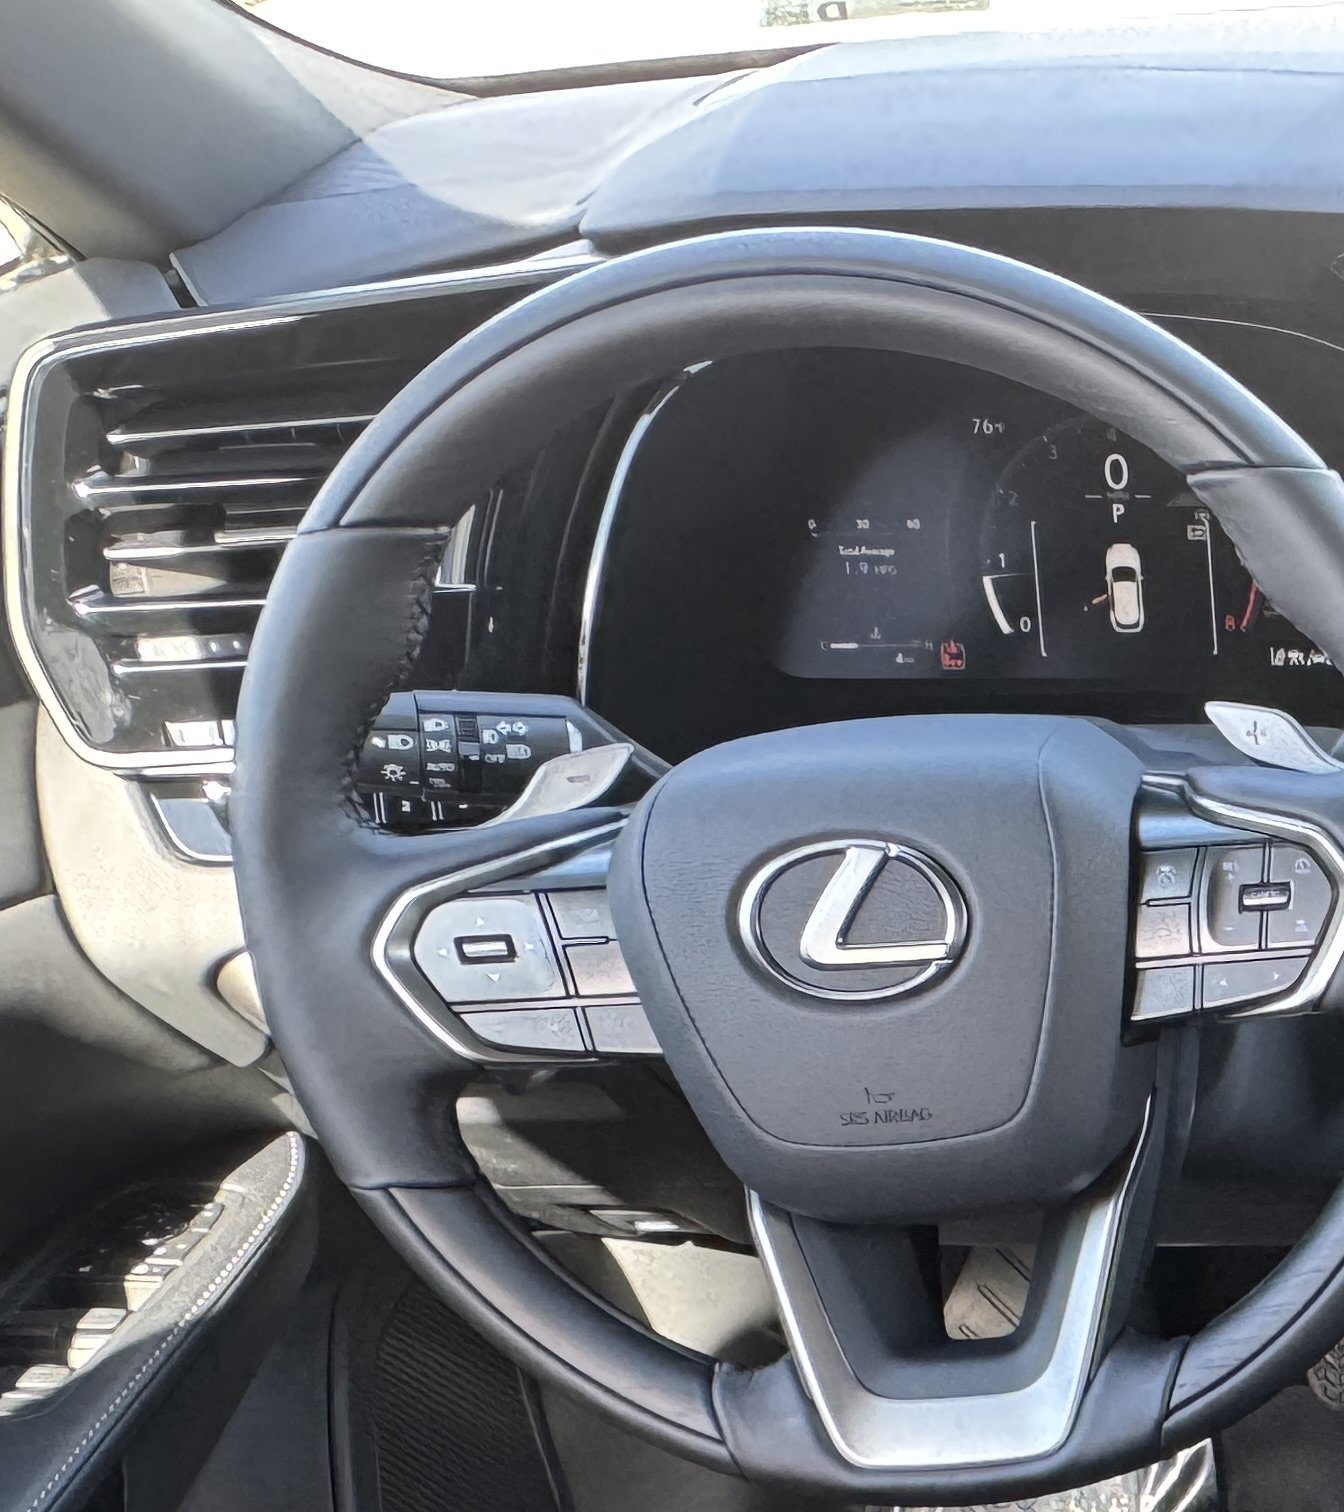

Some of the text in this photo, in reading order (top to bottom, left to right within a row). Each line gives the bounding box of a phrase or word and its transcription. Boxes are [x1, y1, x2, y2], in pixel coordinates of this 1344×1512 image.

[1104, 453, 1129, 491] 0
[1112, 503, 1125, 523] P
[1020, 616, 1032, 633] 0
